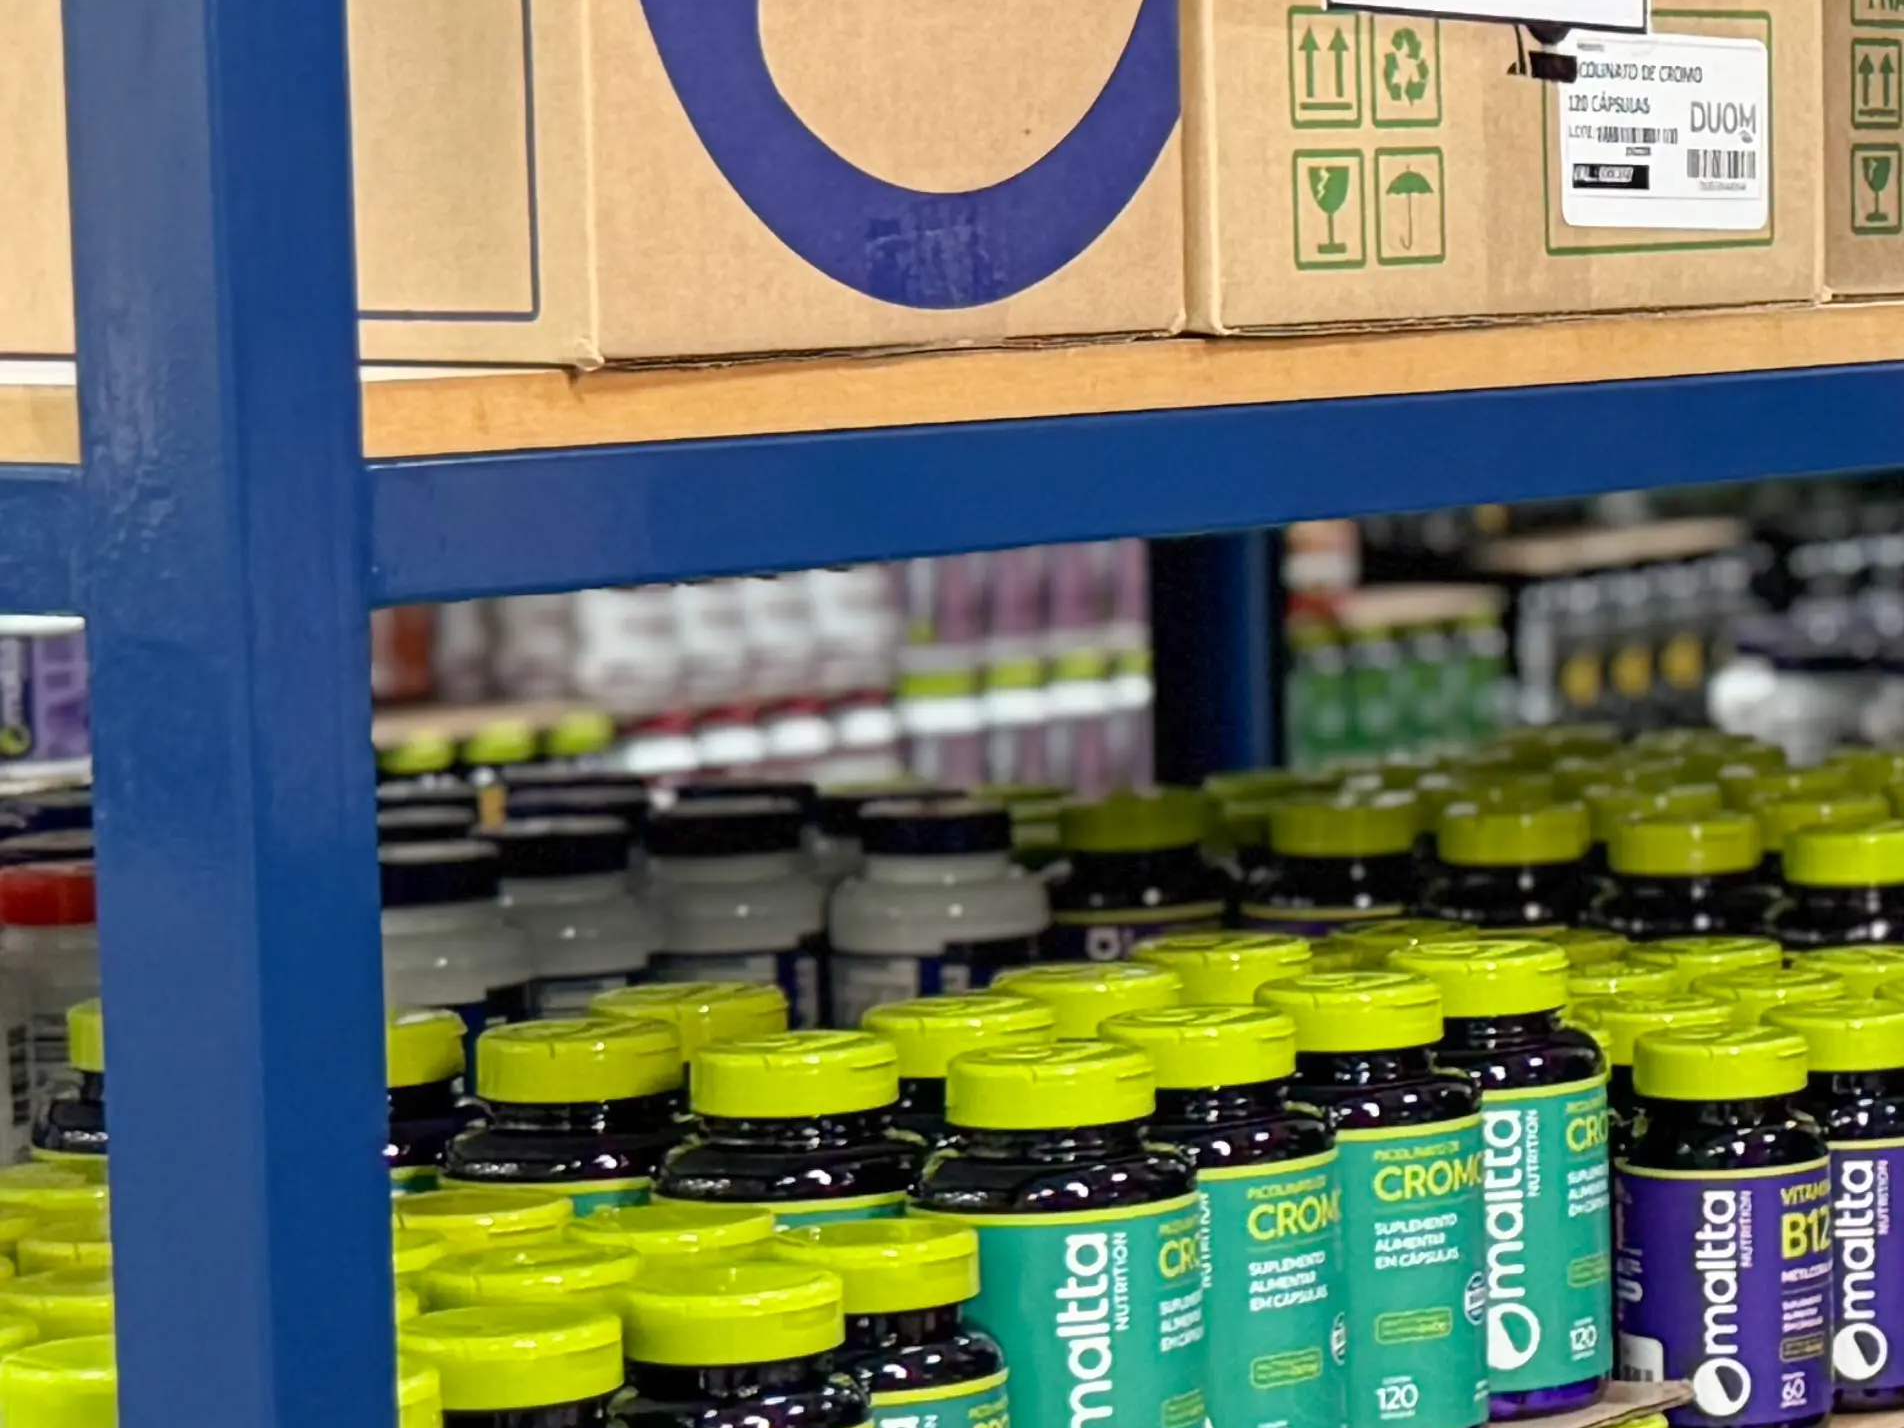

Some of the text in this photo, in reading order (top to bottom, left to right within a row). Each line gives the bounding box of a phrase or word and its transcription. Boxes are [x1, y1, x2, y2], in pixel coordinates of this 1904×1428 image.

[1690, 101, 1757, 142] DUOM
[1526, 1108, 1542, 1198] NUTRITION
[1739, 1190, 1754, 1269] NUTRITION
[1109, 1231, 1130, 1332] NUTRITION
[1694, 1190, 1739, 1356] maltta
[1375, 1382, 1419, 1410] 120
